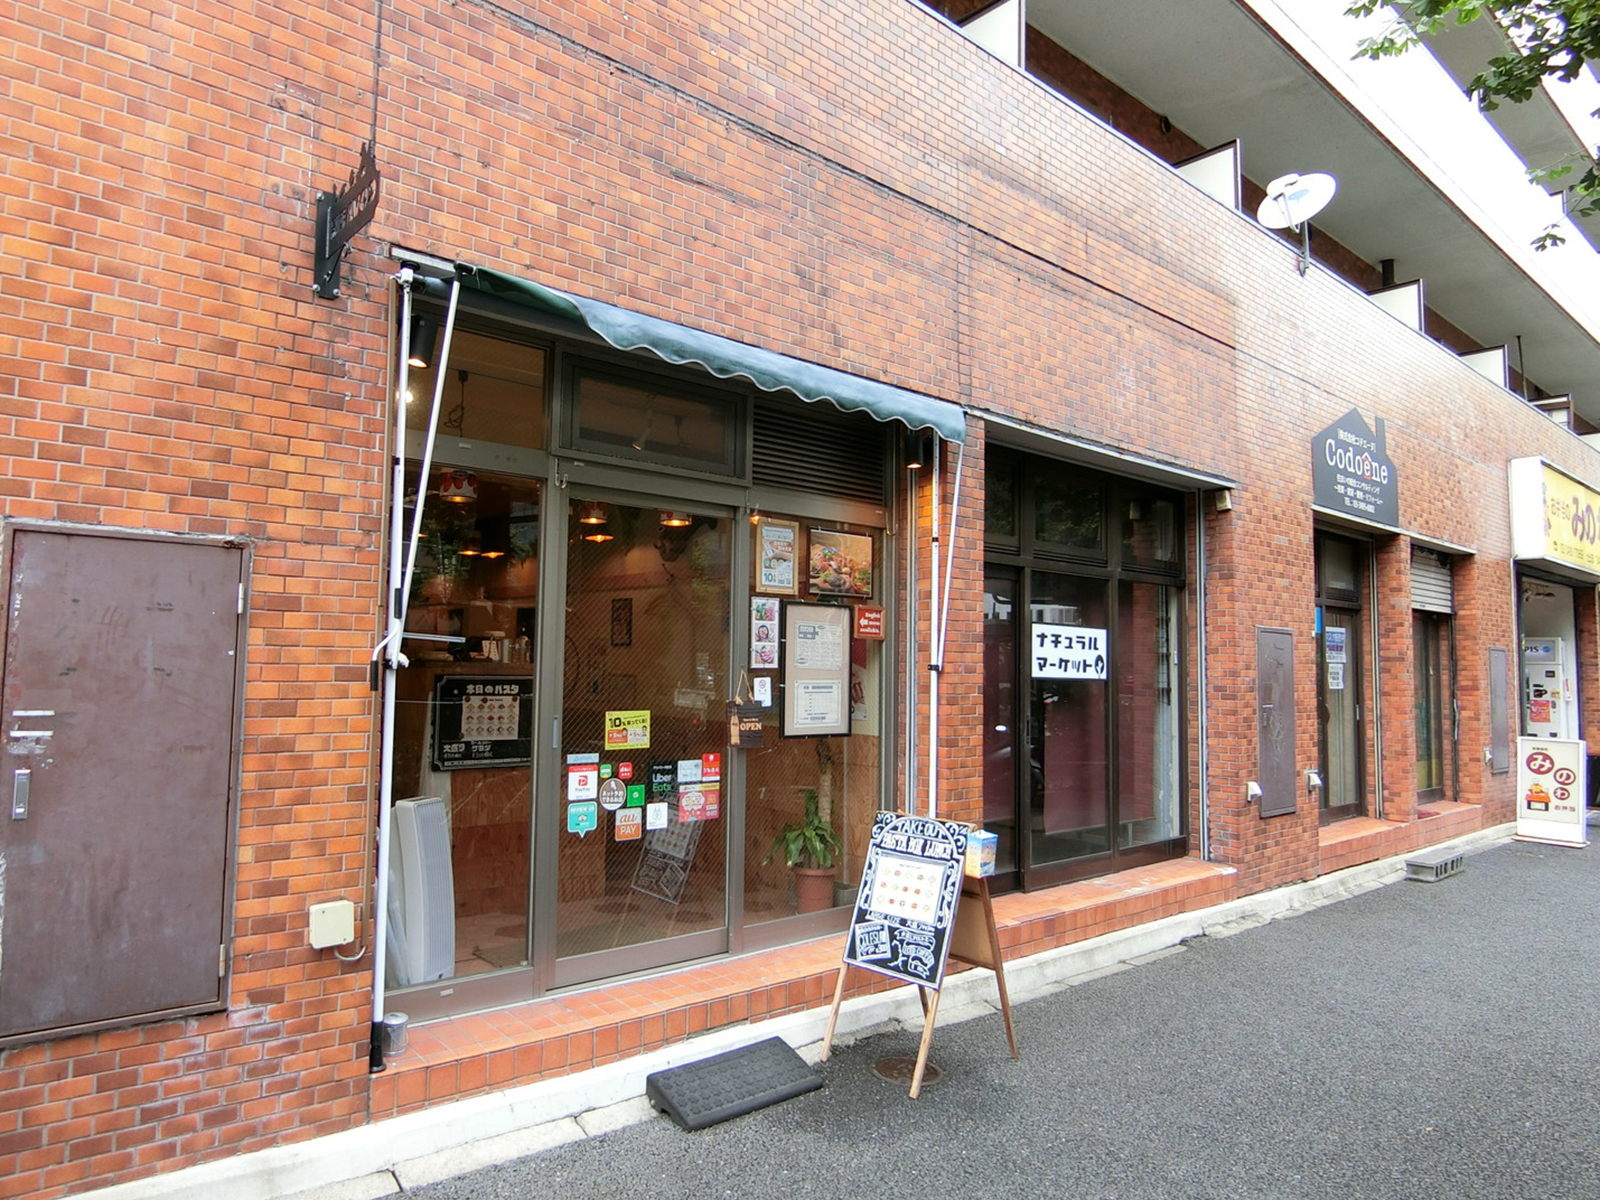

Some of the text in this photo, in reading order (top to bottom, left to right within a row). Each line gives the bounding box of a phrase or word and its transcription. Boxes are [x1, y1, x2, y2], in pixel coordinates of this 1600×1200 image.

[1572, 496, 1600, 545] みの
[1036, 633, 1099, 650] ナチュラル
[1036, 657, 1093, 673] マーケット
[740, 722, 762, 731] OPEN
[652, 773, 672, 782] Uber
[652, 783, 672, 792] Eats
[620, 814, 637, 823] au
[620, 825, 636, 834] PAY
[896, 820, 946, 840] TAKE OUT
